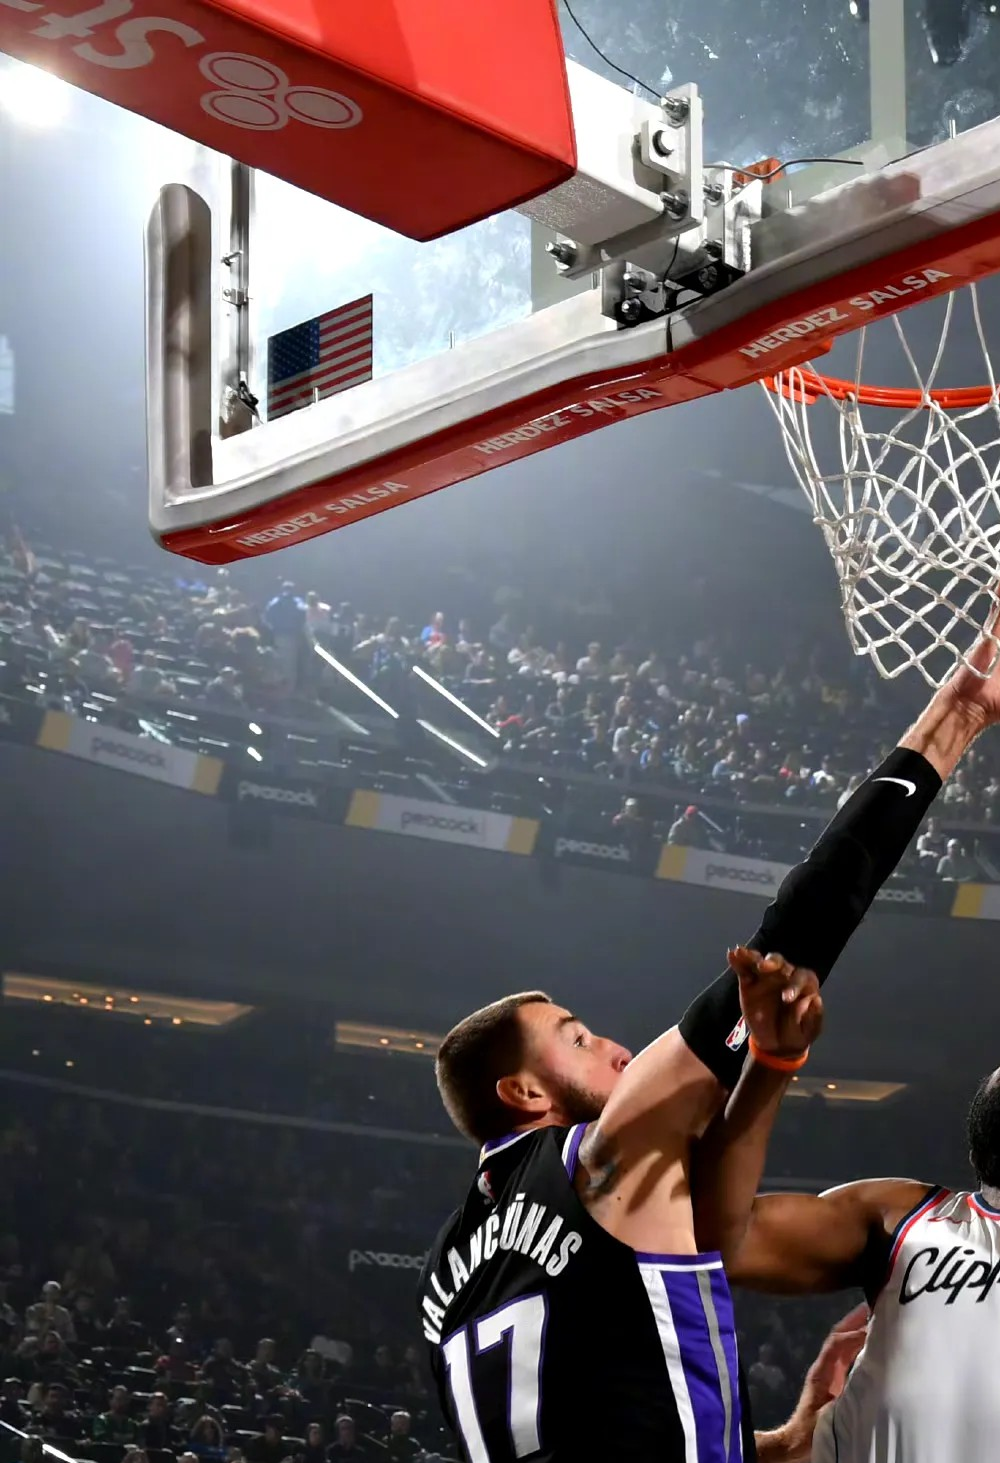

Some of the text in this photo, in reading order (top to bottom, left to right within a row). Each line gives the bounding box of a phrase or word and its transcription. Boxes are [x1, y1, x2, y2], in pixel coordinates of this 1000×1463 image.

[740, 267, 952, 359] HERDEZ SALSA
[473, 386, 664, 455] HERDEZ SALSA
[236, 479, 409, 549] HERDEZ SALSA
[400, 811, 480, 835] peacock
[554, 836, 631, 862] peacock
[704, 861, 776, 887] peacock
